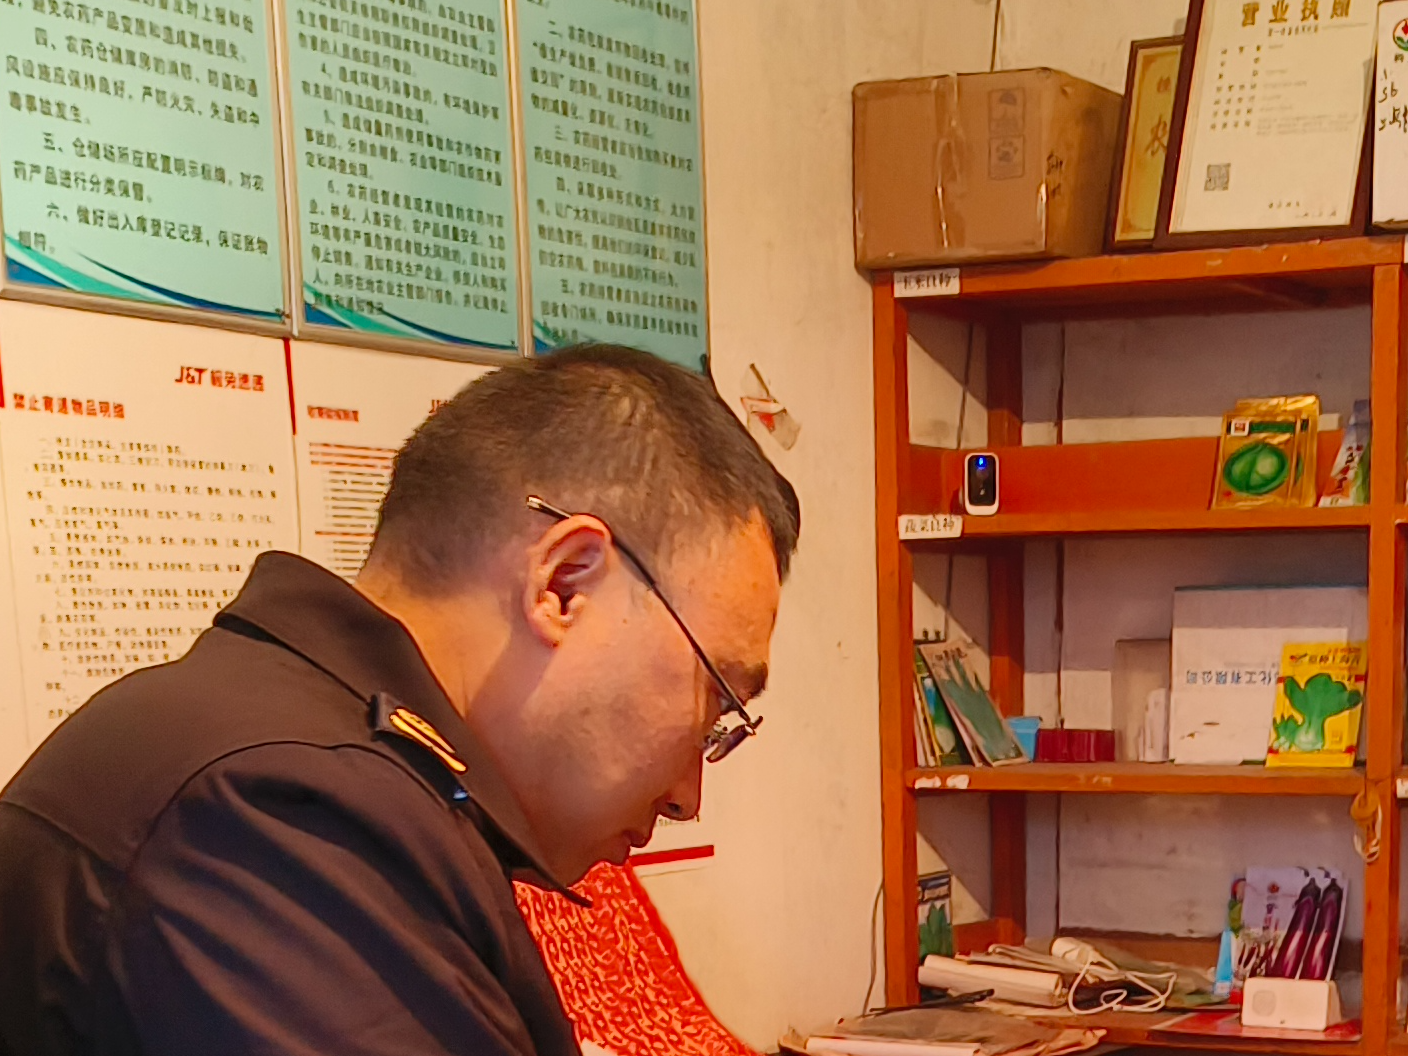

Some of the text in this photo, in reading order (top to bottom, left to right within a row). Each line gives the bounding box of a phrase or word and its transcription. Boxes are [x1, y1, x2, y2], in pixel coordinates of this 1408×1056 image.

[175, 366, 208, 385] J&T
[1186, 668, 1279, 686] 化工有限公司
